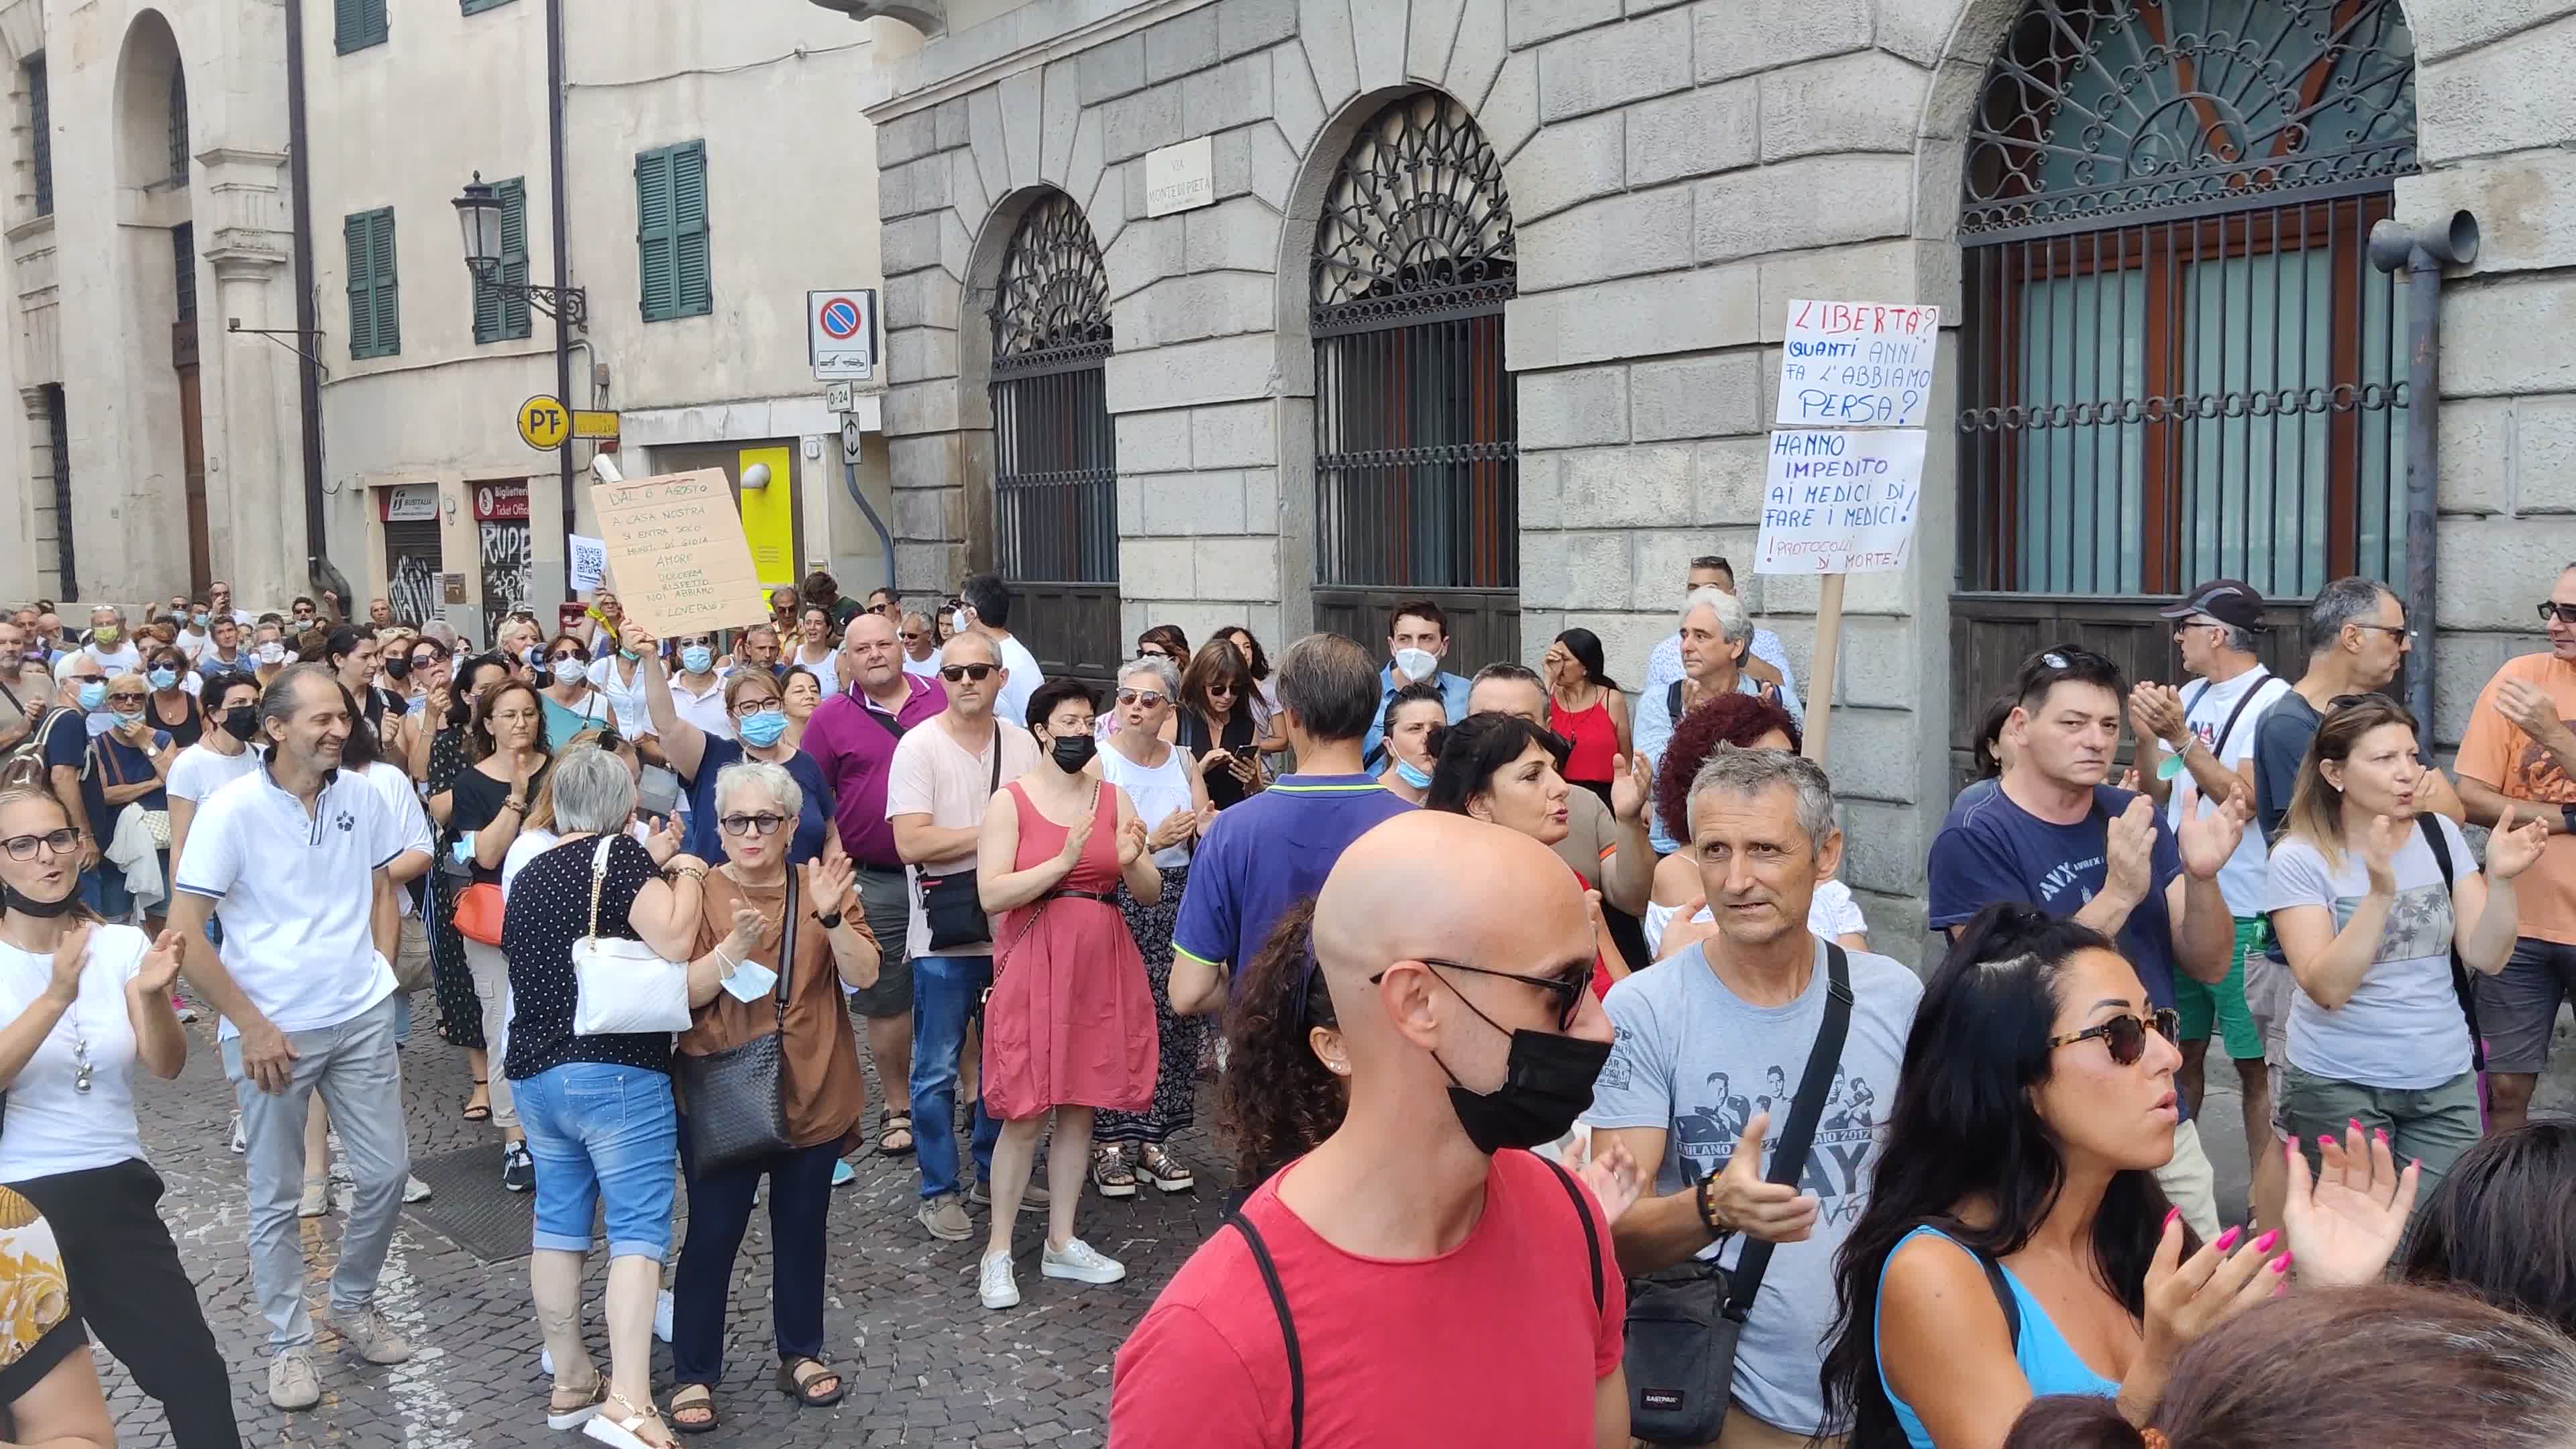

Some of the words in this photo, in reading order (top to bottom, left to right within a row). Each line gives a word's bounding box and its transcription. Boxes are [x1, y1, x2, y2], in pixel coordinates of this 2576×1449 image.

[1786, 364, 1805, 380] FA
[1775, 435, 1845, 456] HANNO
[1786, 458, 1888, 478] IMPEDITO
[495, 487, 528, 499] Biglietteri
[1805, 480, 1872, 503] MEDICI
[627, 513, 655, 525] CASA
[662, 506, 705, 519] NOSTRA
[1766, 508, 1814, 528] FARE
[638, 528, 669, 538] ENTRA
[655, 553, 694, 568] AMORE
[1678, 1142, 1731, 1155] MILANO
